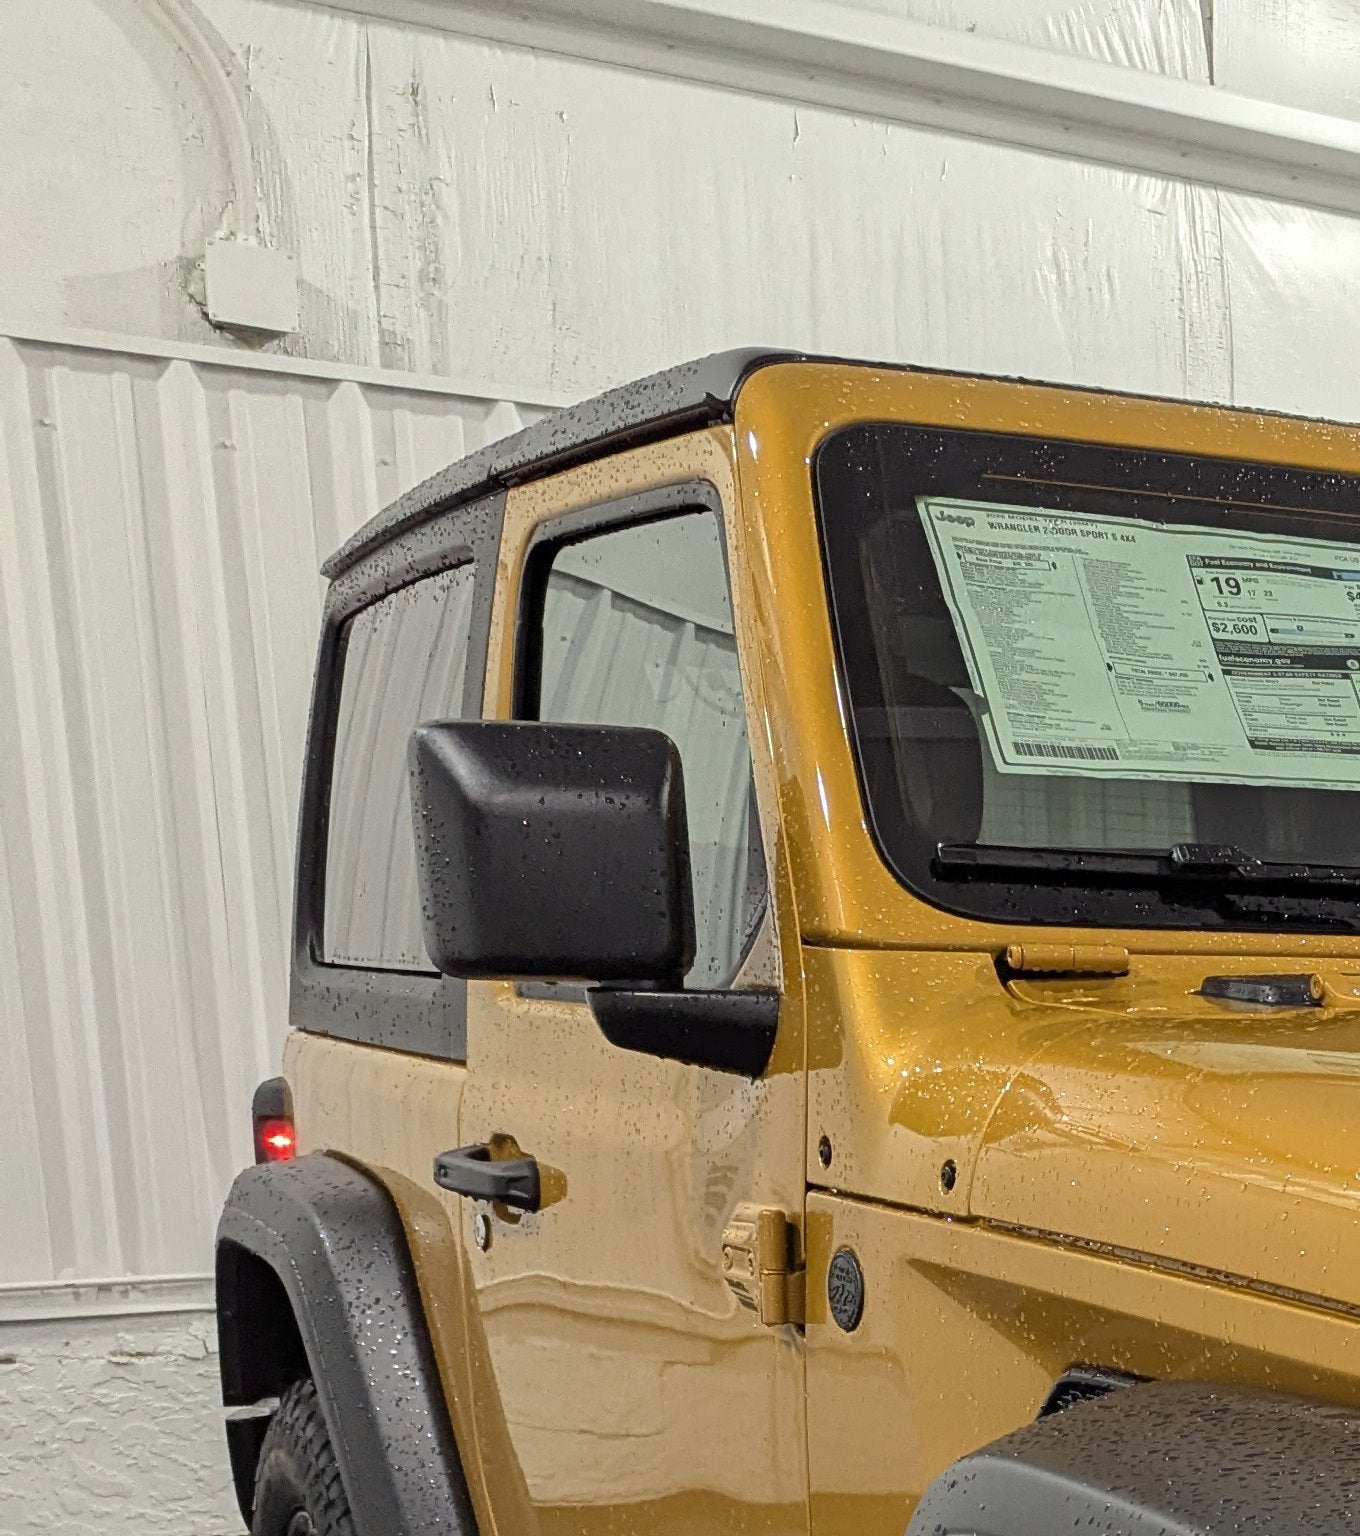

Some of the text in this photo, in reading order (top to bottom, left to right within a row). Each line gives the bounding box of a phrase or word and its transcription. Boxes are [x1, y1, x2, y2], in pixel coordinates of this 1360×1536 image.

[934, 510, 976, 528] Jeep
[987, 521, 1040, 534] WRANGLER
[1079, 529, 1109, 540] SPORT
[1120, 533, 1137, 544] 4X4
[1334, 554, 1348, 562] FCA
[1349, 556, 1360, 564] US
[1209, 576, 1242, 596] 19
[1236, 615, 1258, 624] cost
[1211, 622, 1259, 636] $2,600
